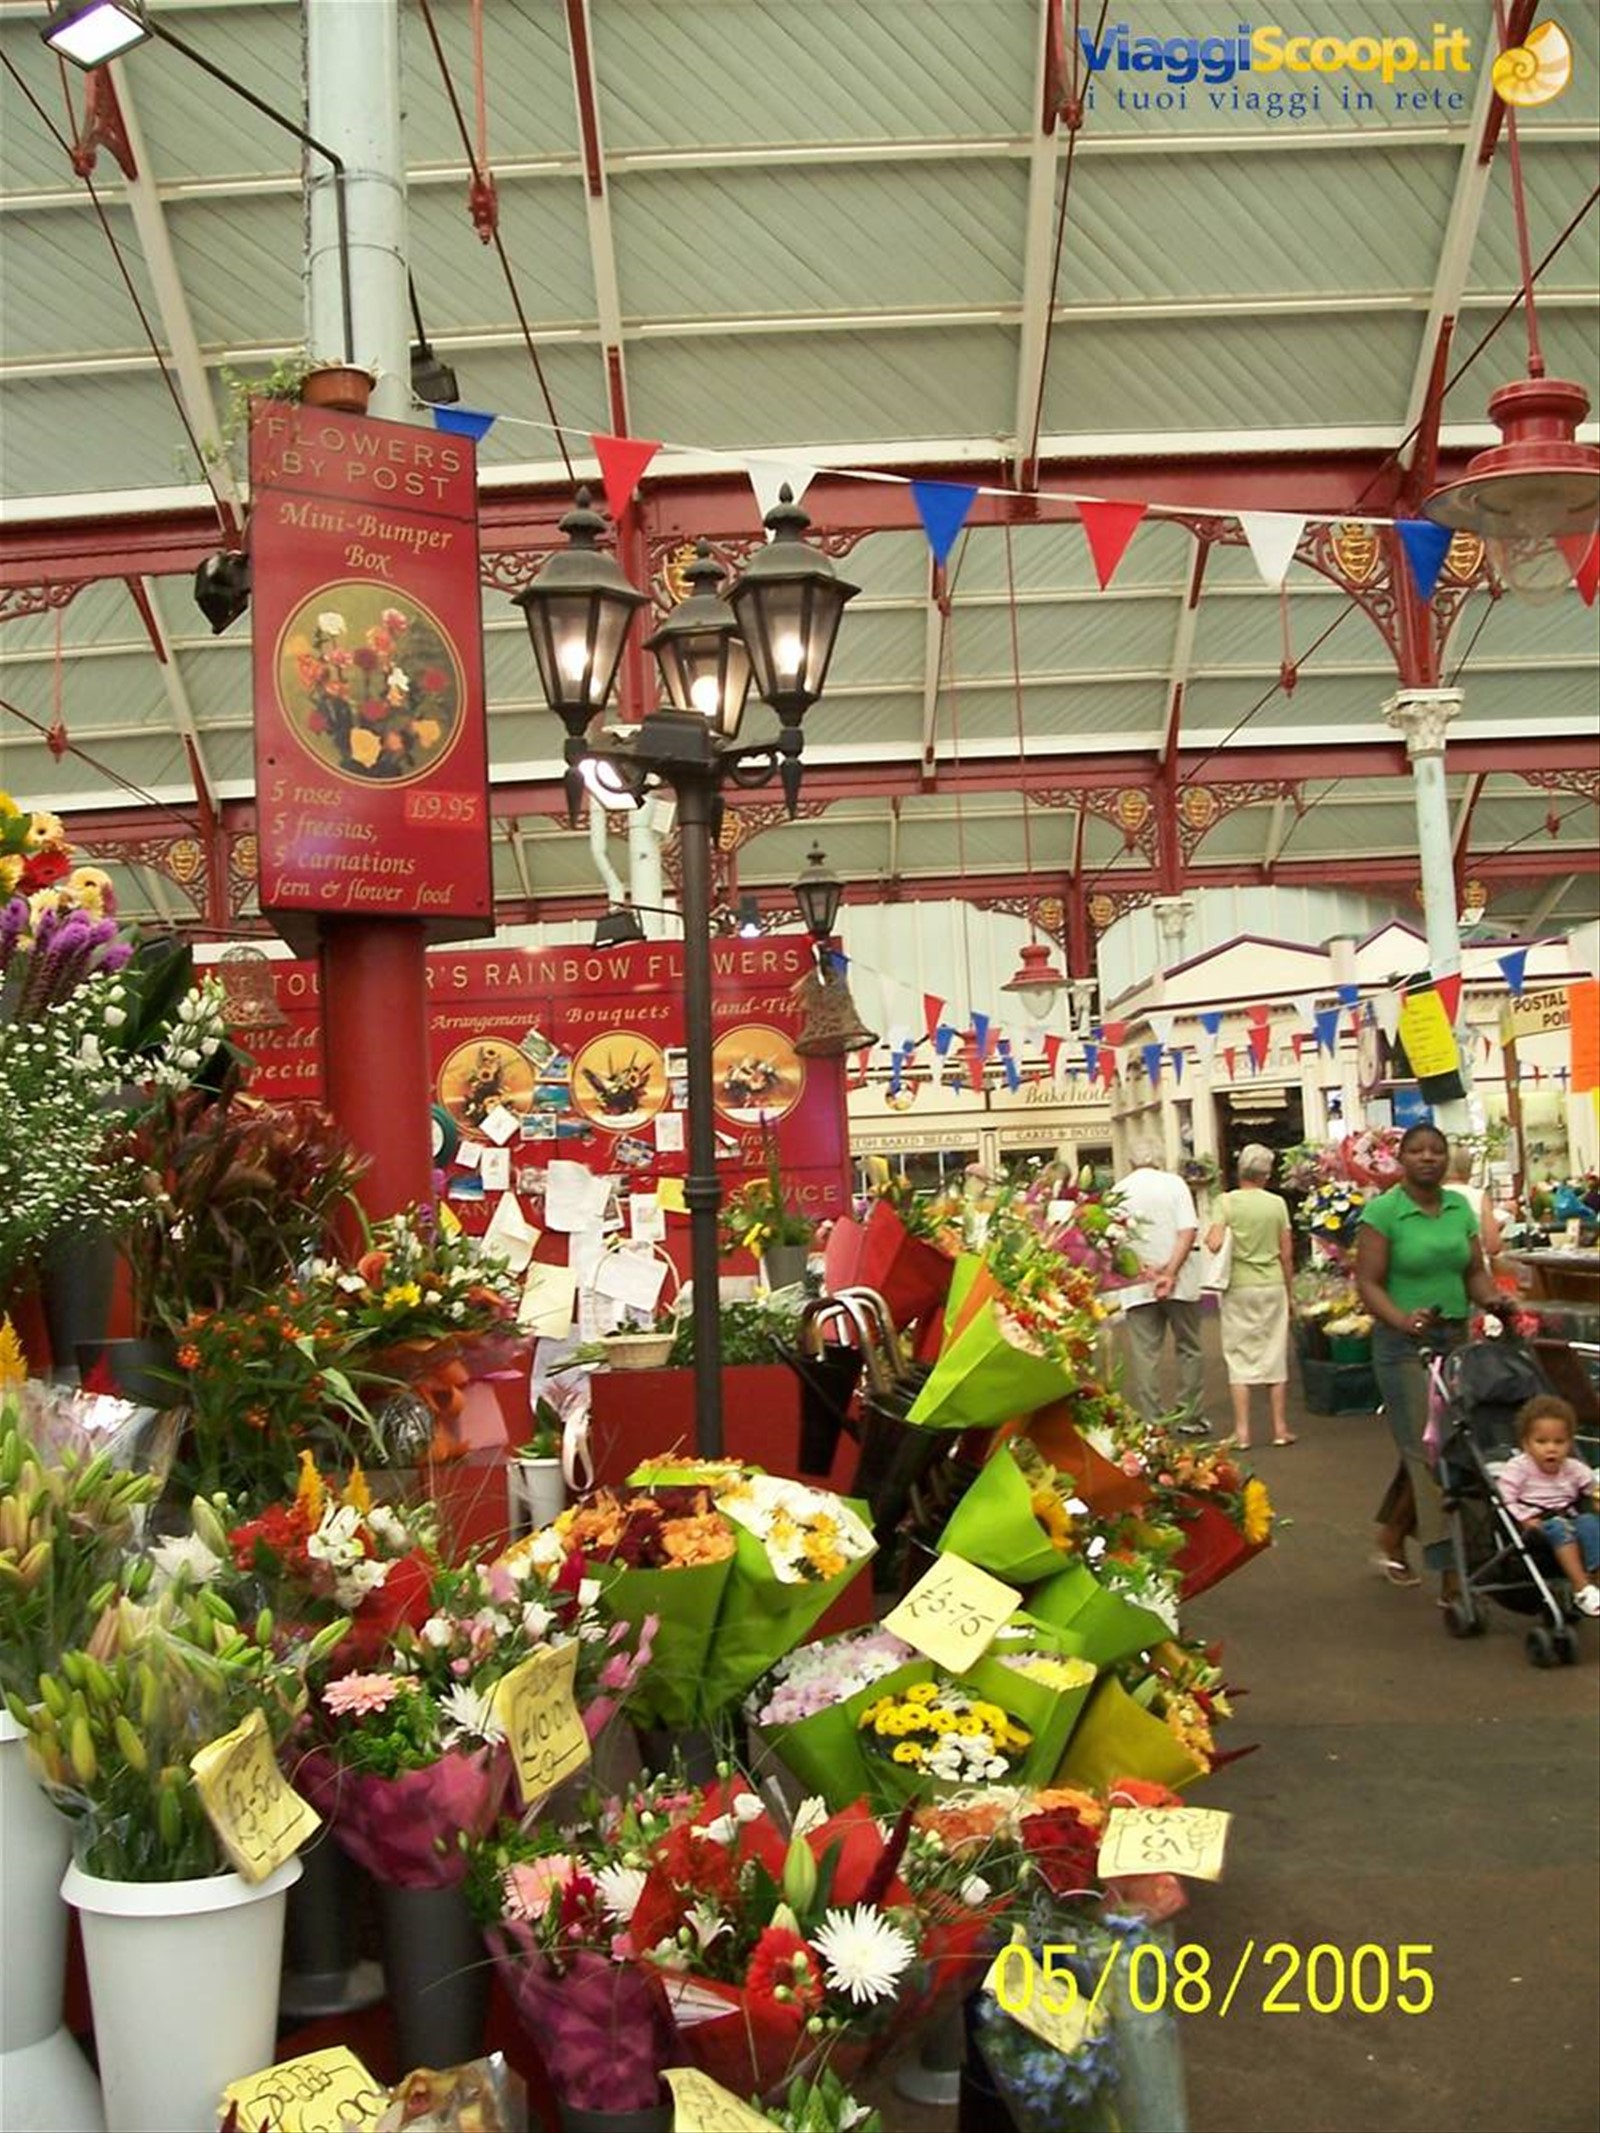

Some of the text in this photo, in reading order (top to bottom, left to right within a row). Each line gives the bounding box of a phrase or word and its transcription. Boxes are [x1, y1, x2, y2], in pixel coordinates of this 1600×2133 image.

[268, 417, 460, 473] FLOWERS
[282, 452, 449, 498] BY POST
[280, 502, 452, 553] Mini-Bumper
[345, 544, 394, 577] Box
[271, 780, 342, 806] 5 roses
[411, 796, 478, 822] £9.95
[272, 813, 288, 834] 5
[272, 845, 416, 875] 5 carnations
[270, 873, 456, 910] fern & flower food
[485, 957, 631, 986] RAINBOW
[648, 949, 799, 978] FLWERS
[430, 1011, 541, 1033] Arrangements
[566, 1005, 672, 1027] Bouquets
[1513, 991, 1568, 1014] POSTAL
[905, 1577, 995, 1637] £3.75
